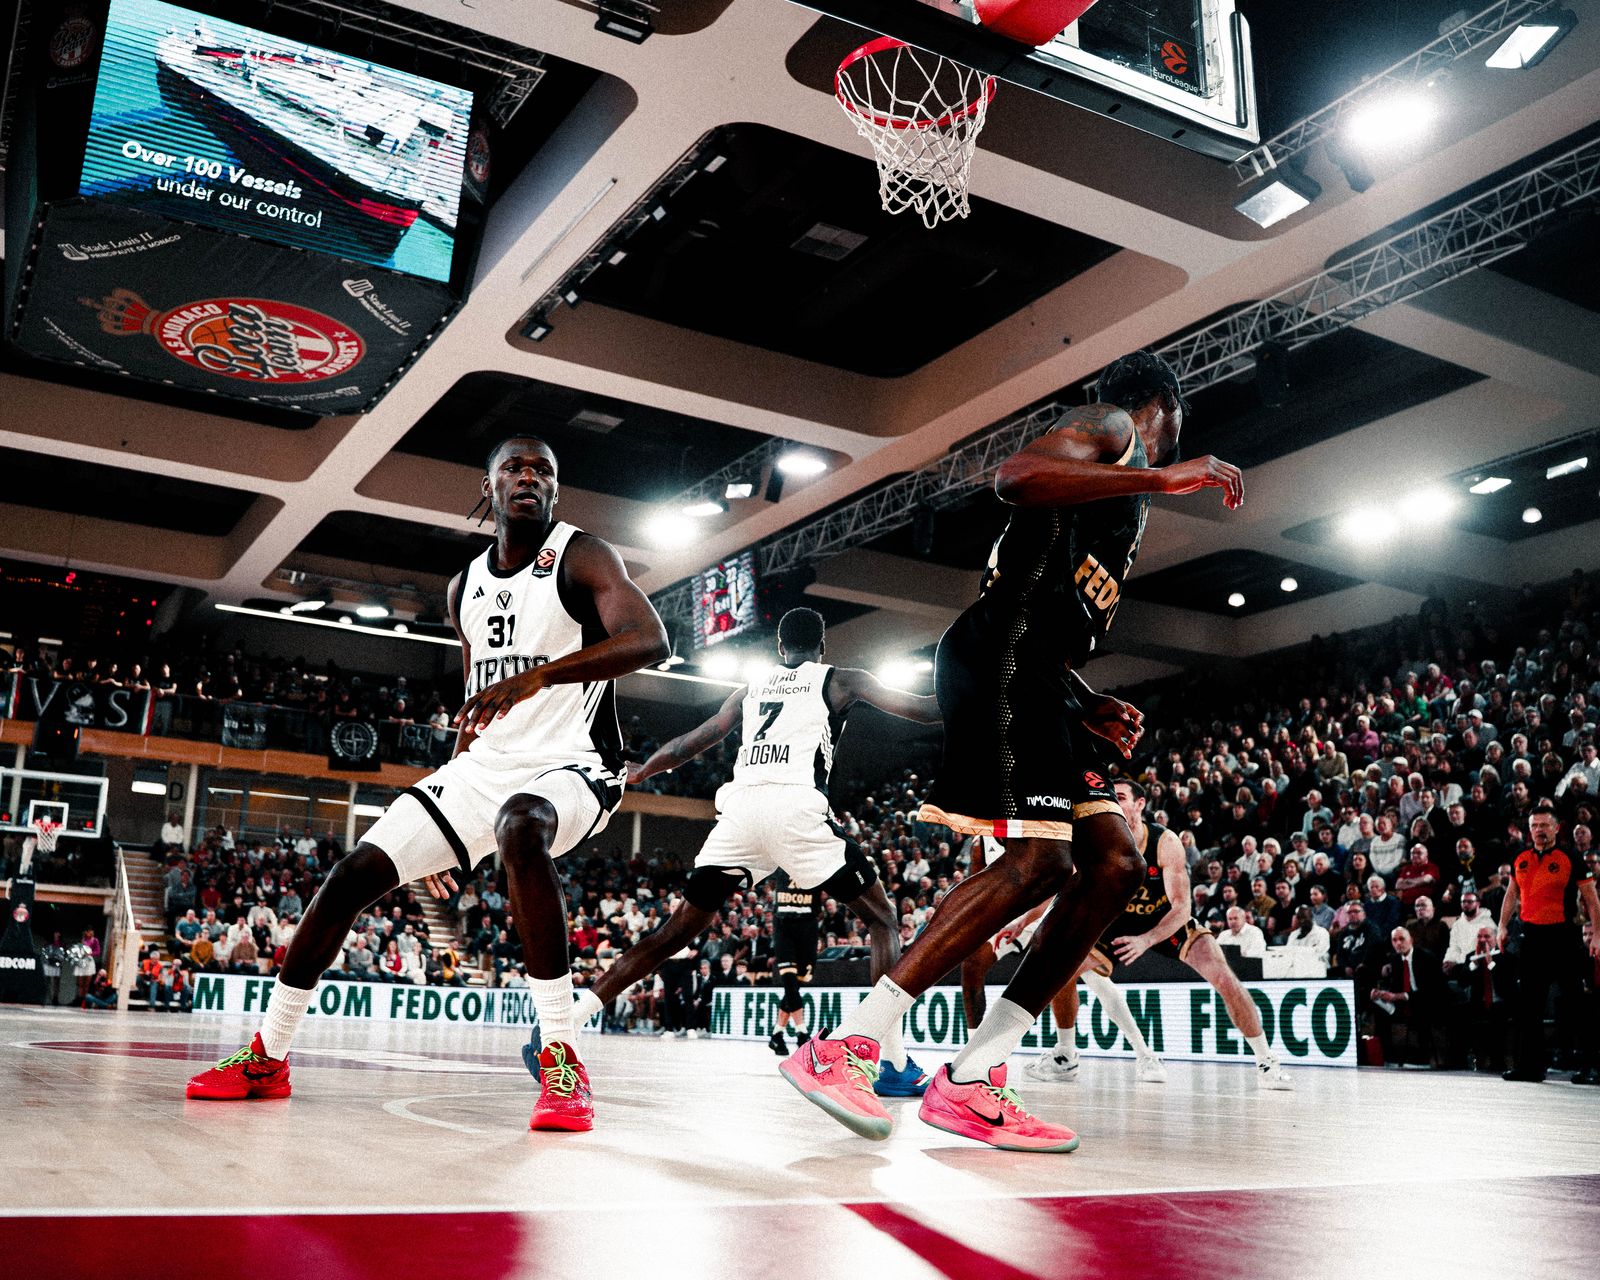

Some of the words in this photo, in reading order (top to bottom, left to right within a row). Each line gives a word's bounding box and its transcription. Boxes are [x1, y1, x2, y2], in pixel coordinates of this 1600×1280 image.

[122, 140, 177, 168] Over
[184, 156, 222, 179] 100
[229, 165, 303, 200] Vessels
[156, 177, 215, 202] under
[219, 192, 252, 211] our
[256, 201, 323, 229] control
[80, 242, 110, 253] Stade
[109, 236, 140, 249] Louis
[139, 232, 154, 241] II
[147, 234, 181, 249] MONACO
[317, 340, 359, 375] BASKET
[487, 614, 516, 648] 31
[28, 677, 63, 717] V
[104, 690, 131, 727] S
[762, 682, 811, 697] Pelliconi
[753, 701, 784, 742] 7
[777, 892, 813, 905] FEDCOM
[0, 956, 36, 970] EDCOM
[193, 977, 225, 1011] M
[243, 979, 372, 1018] FEOM
[501, 991, 539, 1025] FEDCO
[711, 992, 731, 1034] M
